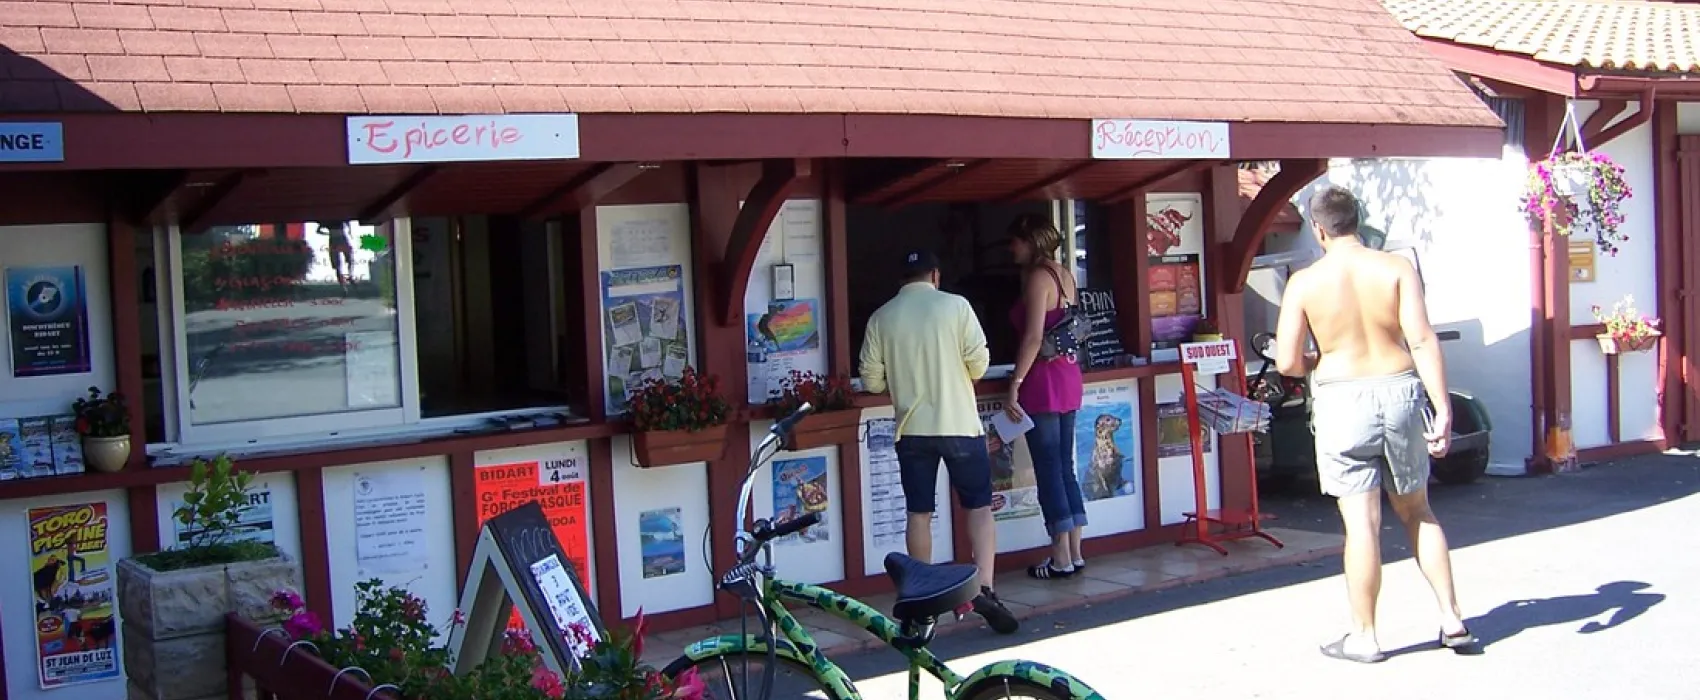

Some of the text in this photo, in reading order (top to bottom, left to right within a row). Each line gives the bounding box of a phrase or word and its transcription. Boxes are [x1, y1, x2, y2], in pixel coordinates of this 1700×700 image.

[363, 121, 523, 158] Epicerie
[1081, 290, 1115, 311] PAIN
[1186, 344, 1230, 359] SUD OUEST
[545, 459, 576, 470] LUNDI
[481, 467, 533, 481] BIDART
[550, 470, 560, 482] 4
[502, 485, 559, 500] Festival
[564, 482, 580, 492] de
[33, 508, 92, 536] TORO
[46, 658, 57, 668] ST
[58, 654, 80, 667] JEAN
[82, 653, 93, 663] DE
